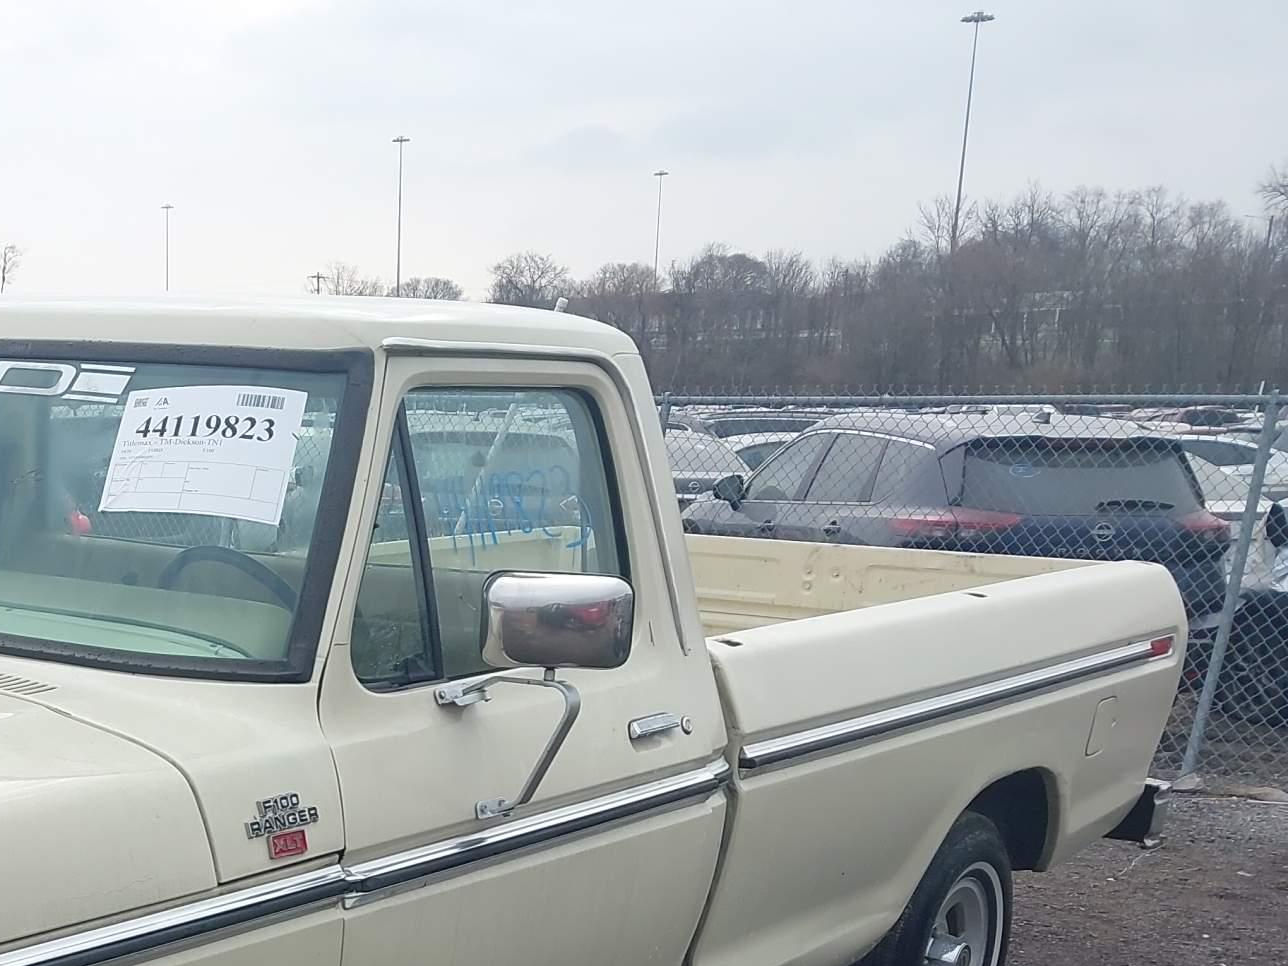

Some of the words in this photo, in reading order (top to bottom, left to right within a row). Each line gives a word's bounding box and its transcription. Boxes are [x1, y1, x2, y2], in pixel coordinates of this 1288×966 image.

[136, 414, 276, 441] 44119823
[259, 793, 300, 816] F100
[247, 806, 319, 837] RANGER
